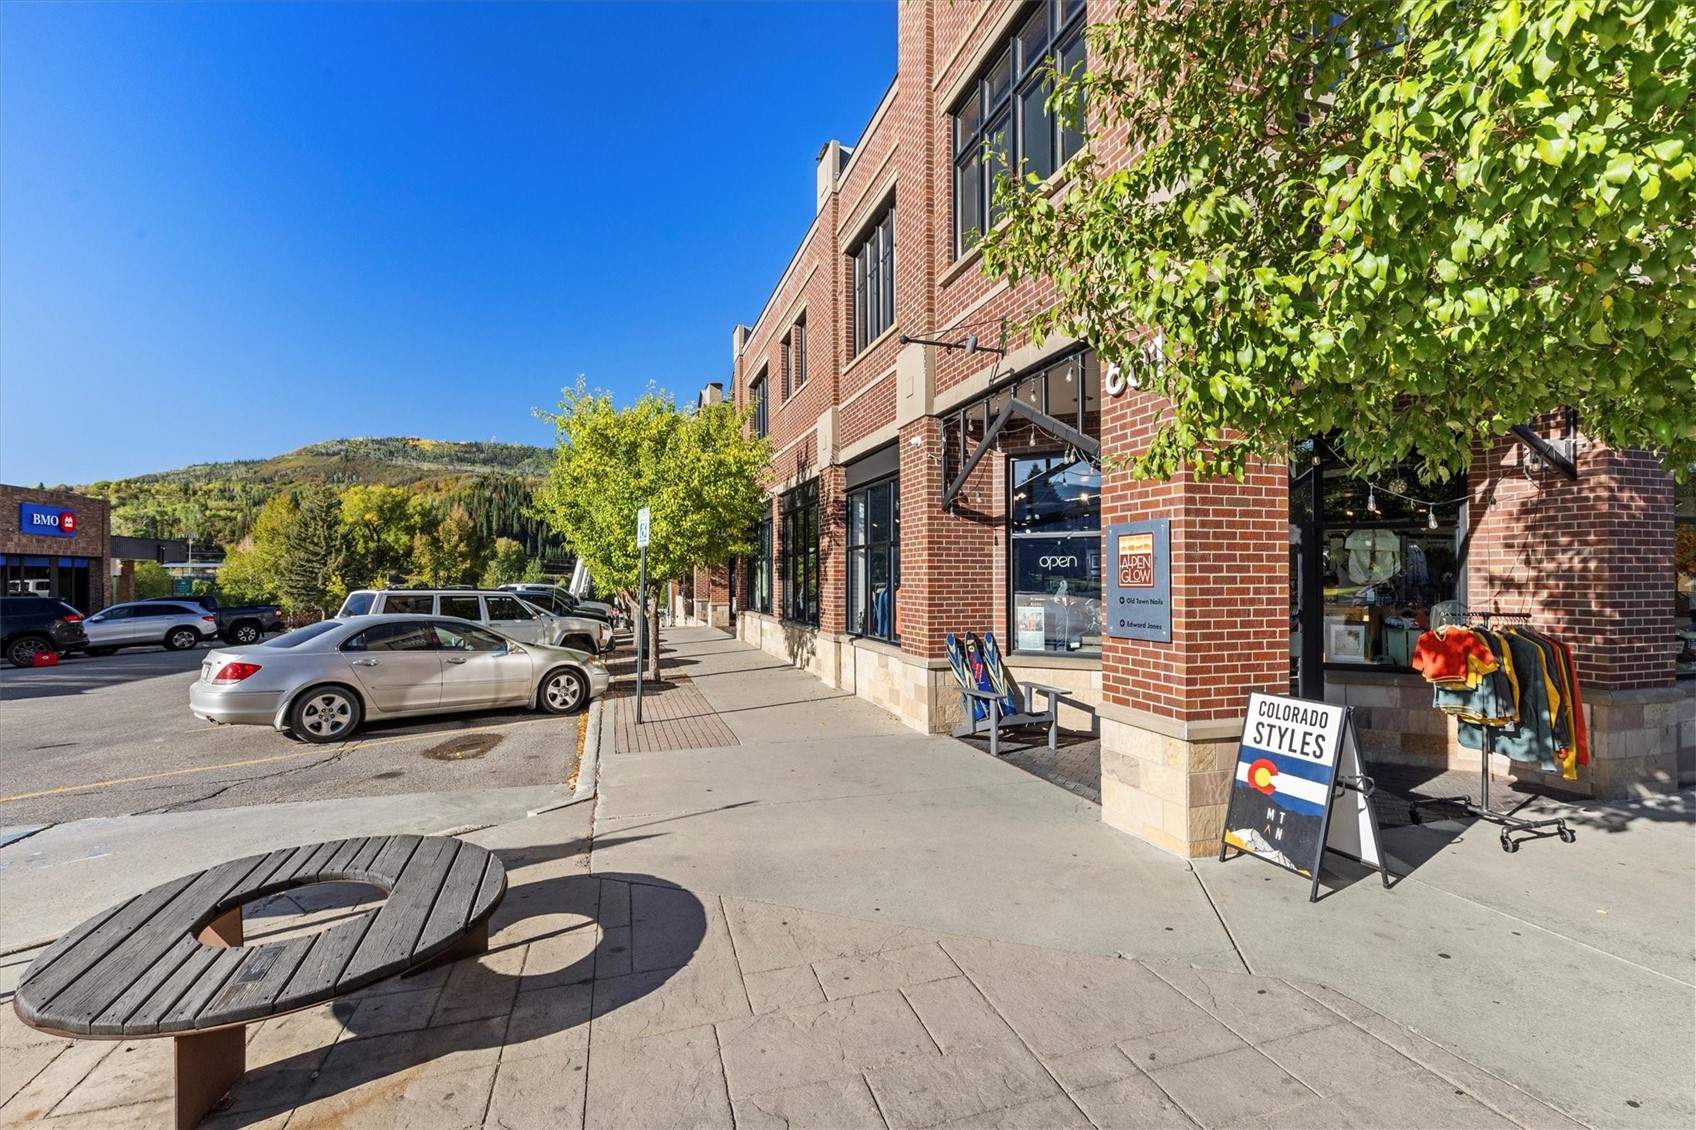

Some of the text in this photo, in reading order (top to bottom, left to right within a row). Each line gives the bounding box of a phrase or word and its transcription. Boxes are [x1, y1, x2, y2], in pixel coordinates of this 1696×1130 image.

[32, 513, 59, 526] BMO
[1039, 555, 1078, 571] open
[1120, 554, 1151, 569] ALPEN
[1121, 569, 1151, 583] GLOW
[1136, 597, 1150, 605] Town
[1147, 622, 1162, 630] Jones
[1258, 700, 1329, 729] COLORADO
[1253, 721, 1326, 759] STYLES
